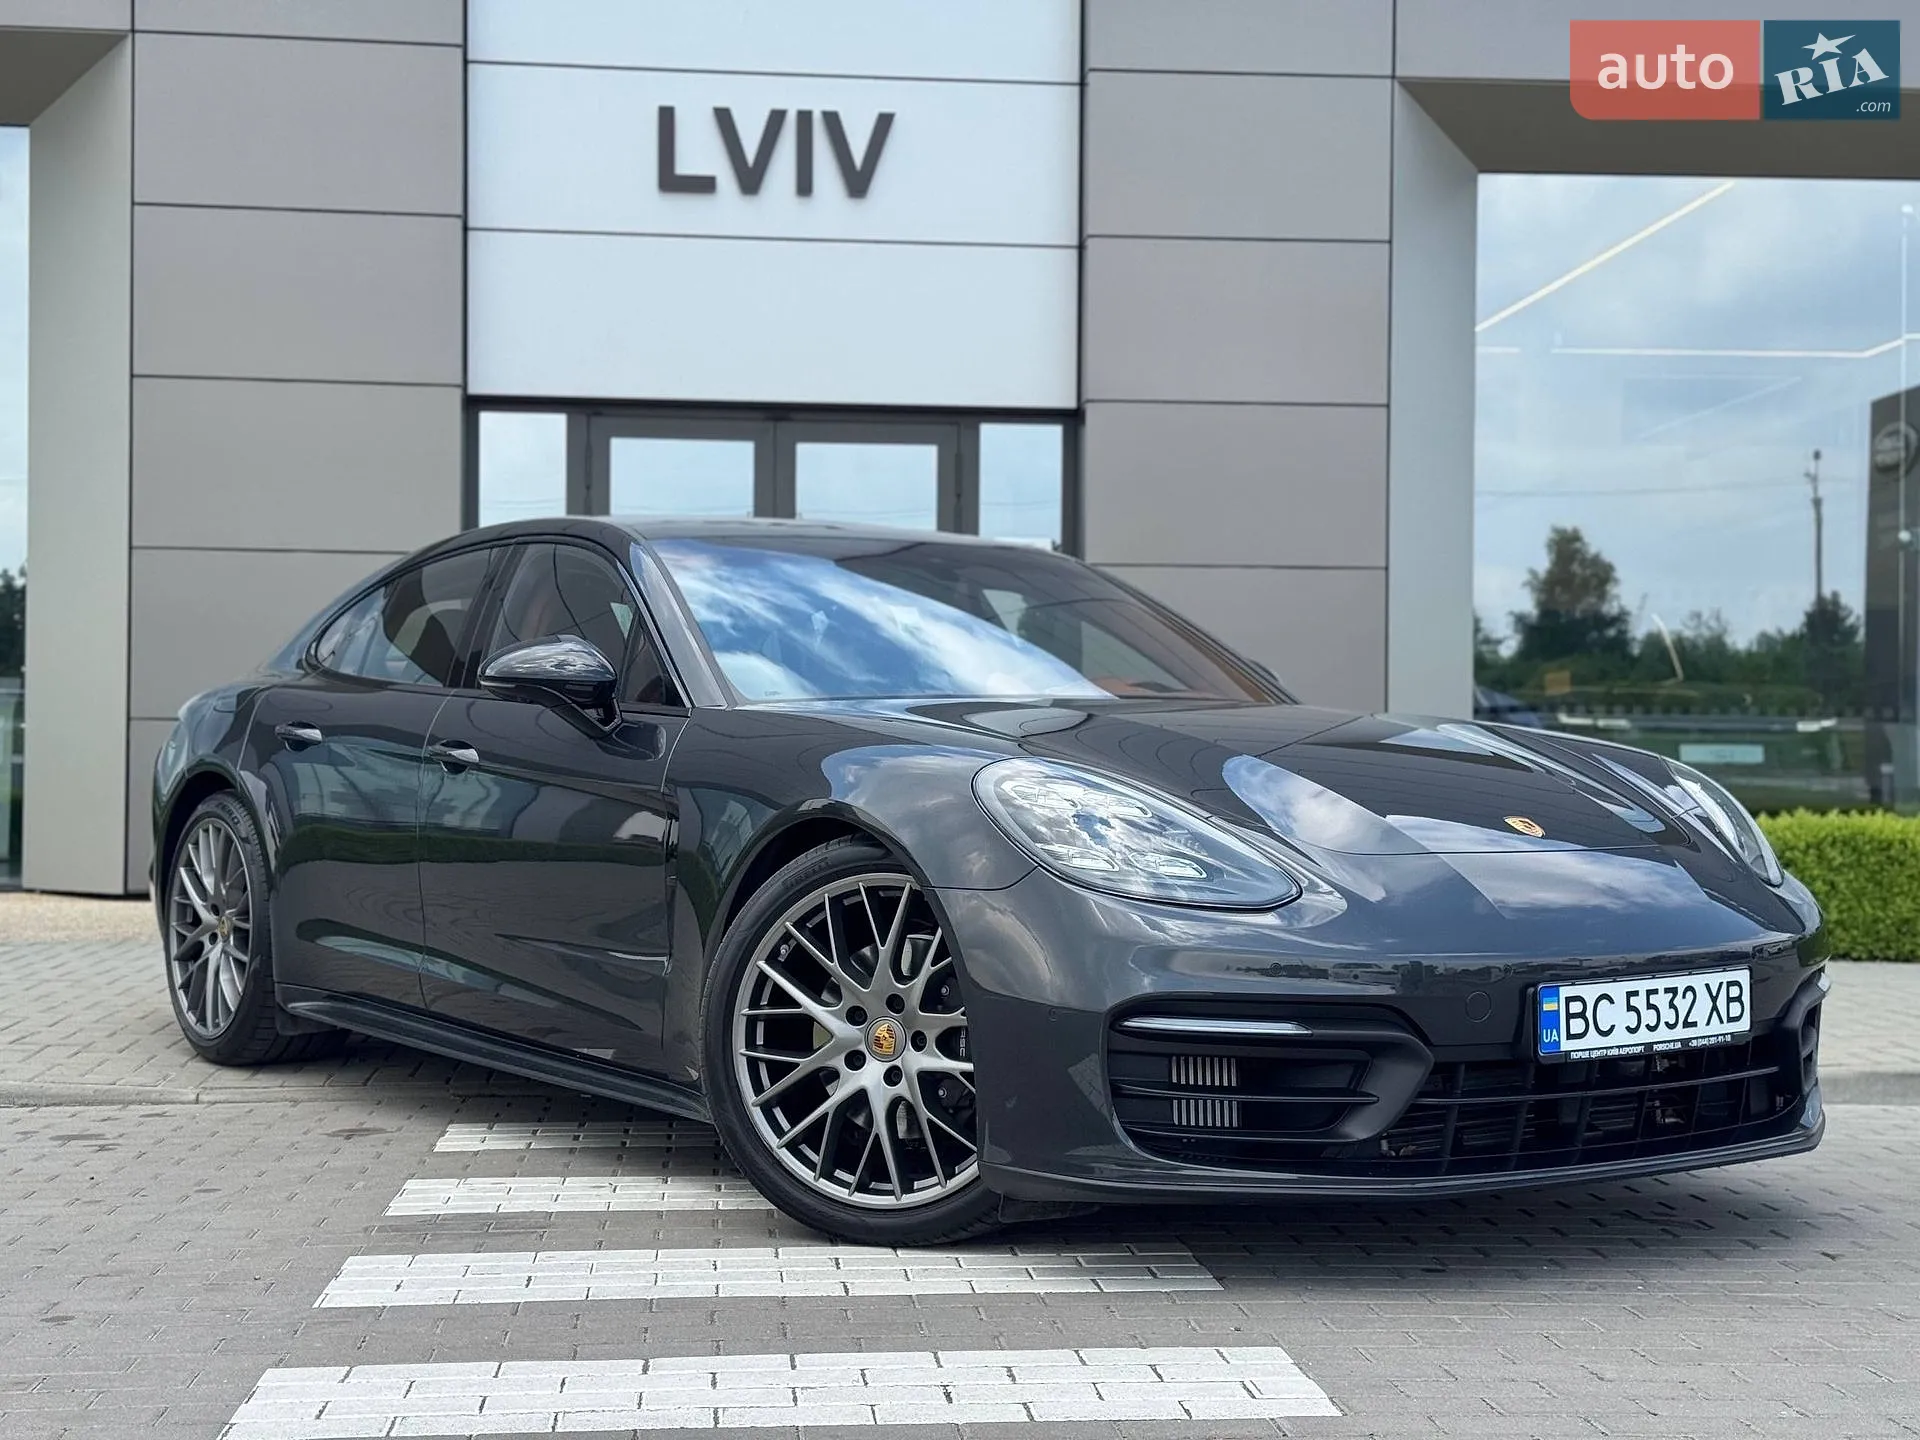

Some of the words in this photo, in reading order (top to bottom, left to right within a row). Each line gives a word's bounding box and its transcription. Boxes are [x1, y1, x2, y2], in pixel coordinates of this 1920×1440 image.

[658, 105, 896, 199] LVIV
[1543, 1028, 1559, 1043] UA
[1564, 992, 1616, 1041] BC
[1624, 984, 1698, 1035] 5532
[1704, 979, 1745, 1027] XB
